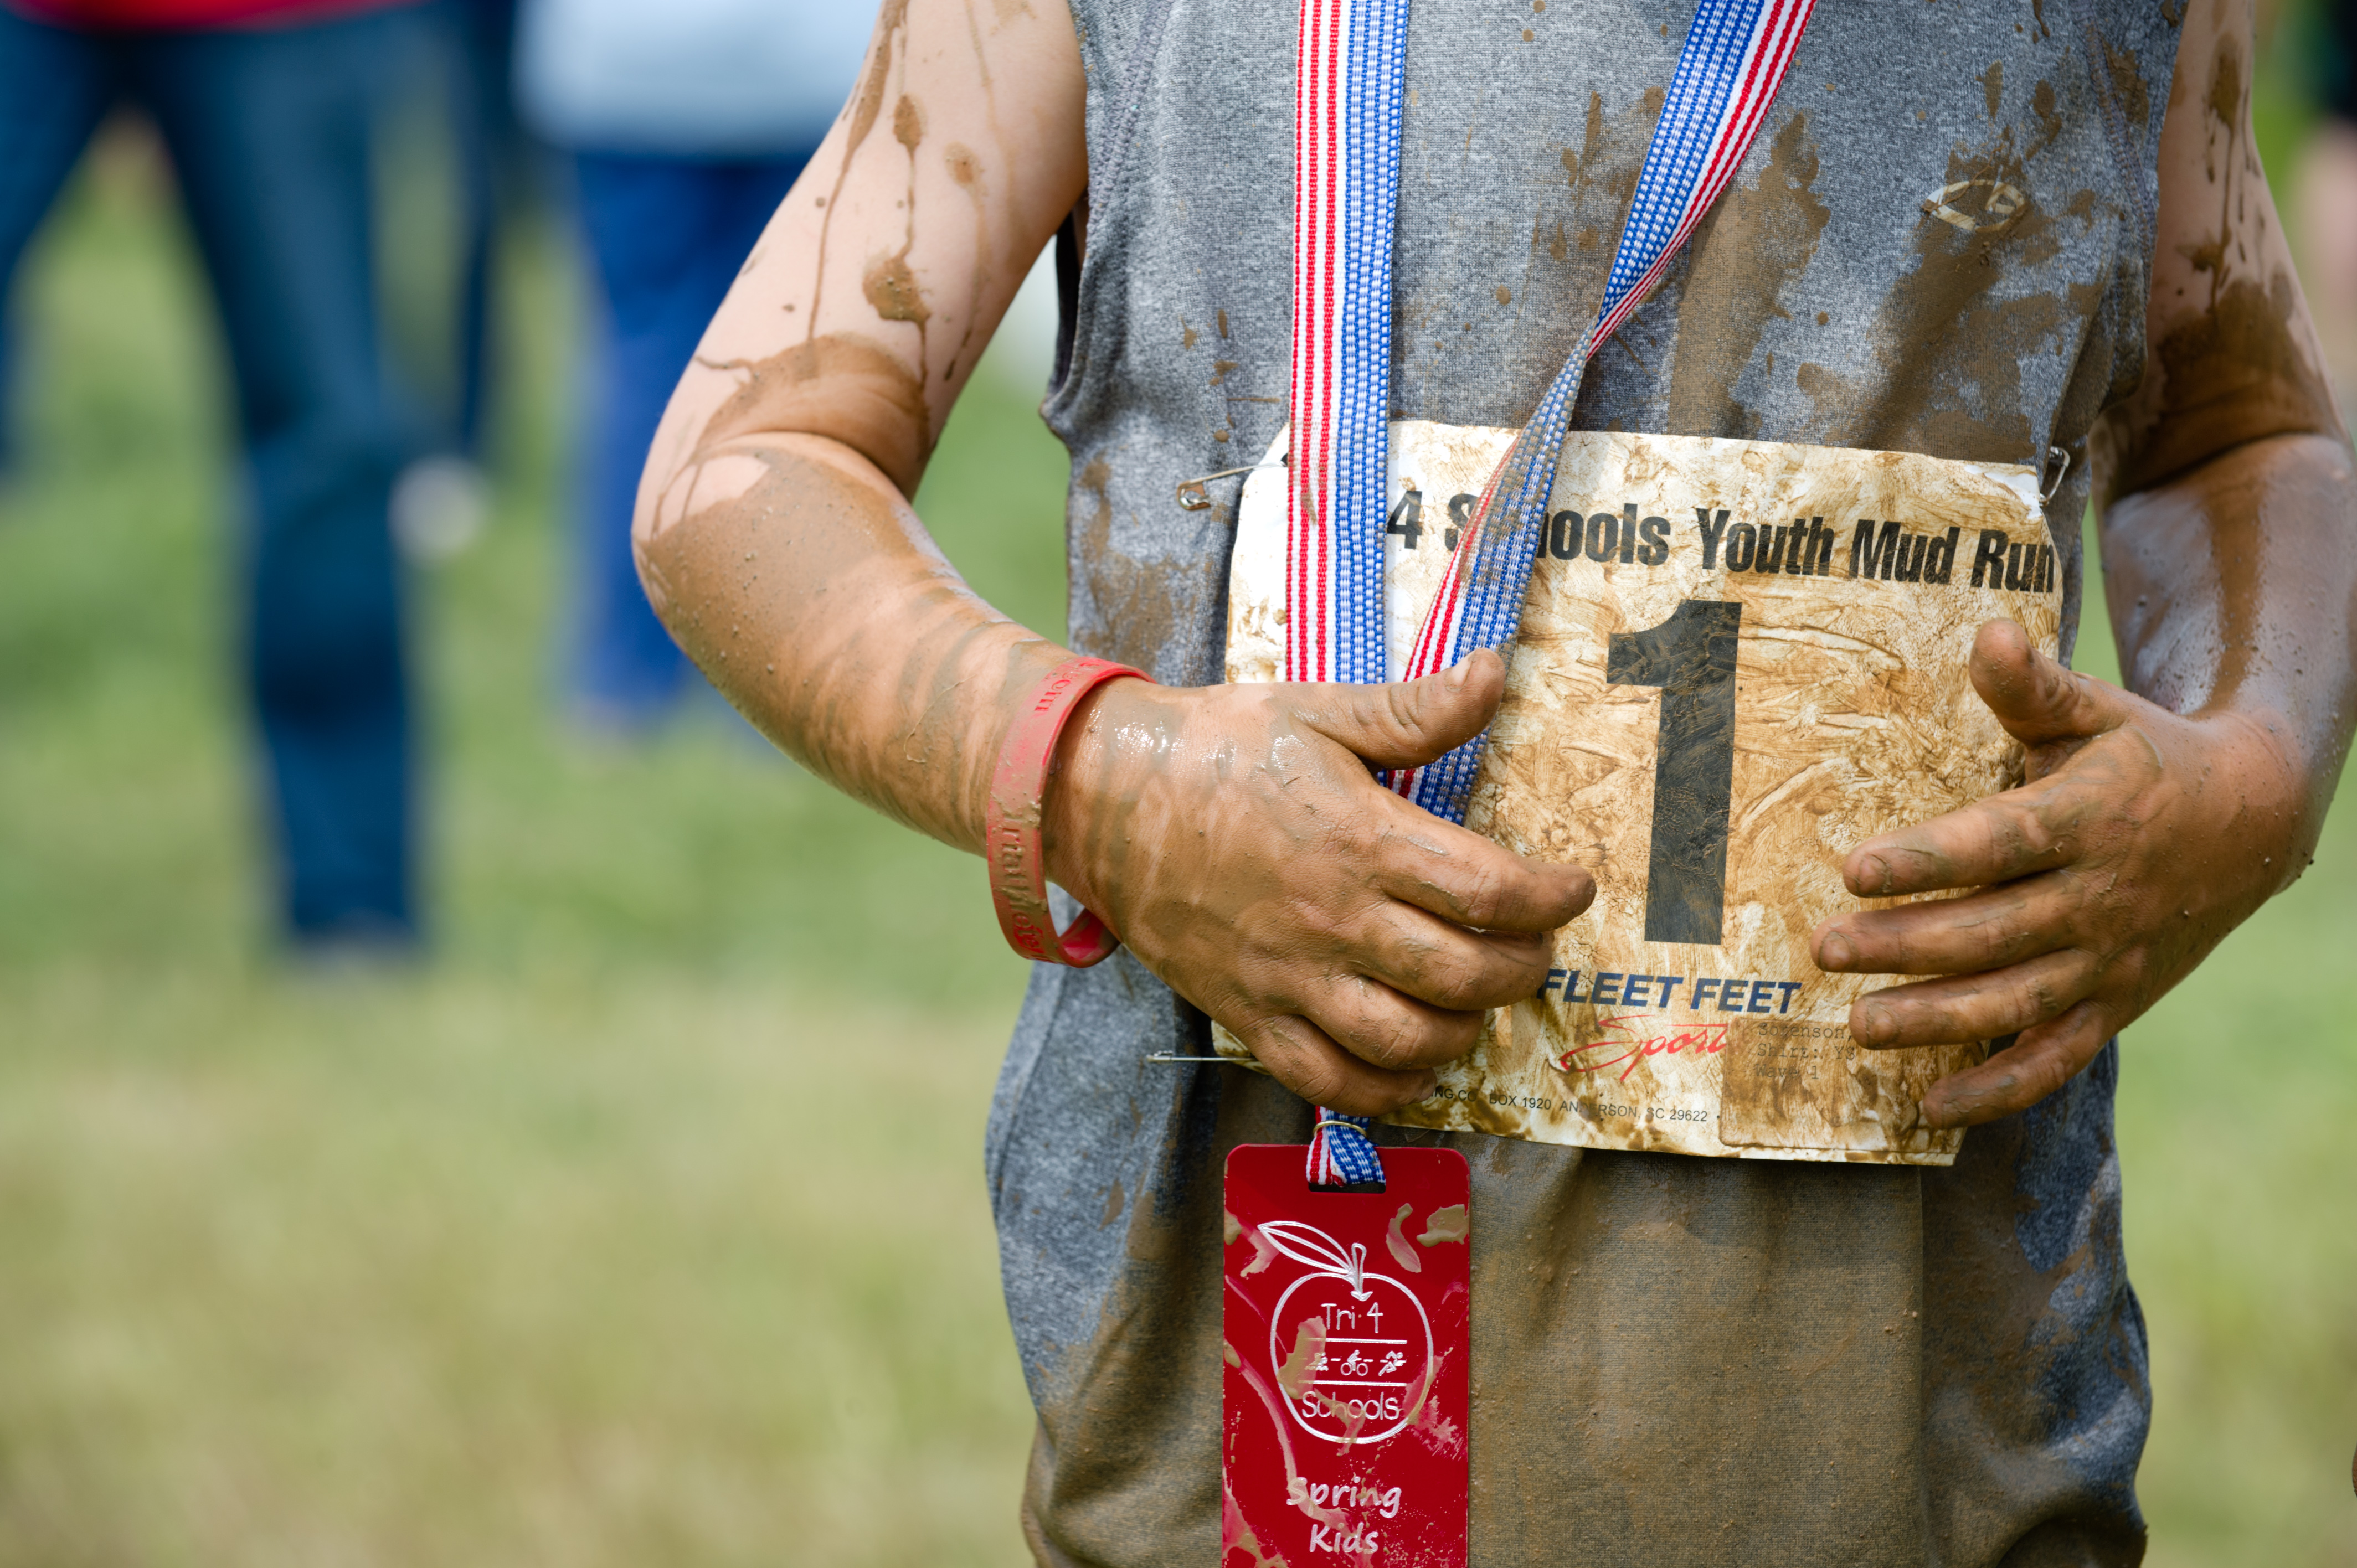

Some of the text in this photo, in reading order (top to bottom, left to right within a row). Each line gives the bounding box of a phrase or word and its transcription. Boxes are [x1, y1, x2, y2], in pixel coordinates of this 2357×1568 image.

[1387, 491, 2054, 594] 4 Sools Youth Mud Run
[1607, 599, 1742, 945] 1
[1537, 969, 1803, 1014] FLEET FEET
[1757, 1043, 1818, 1058] Shirt:
[1755, 1063, 1820, 1080] Wave 1
[1489, 1093, 1517, 1107] BOX
[1522, 1097, 1552, 1110] 1920
[1559, 1100, 1641, 1119] ANDERSON,
[1646, 1107, 1665, 1120] SC
[1670, 1108, 1708, 1122] 29622
[1320, 1302, 1383, 1333] Tri 4
[1300, 1390, 1400, 1420] Schools
[1286, 1476, 1402, 1519] Spring
[1309, 1521, 1379, 1554] Kids
